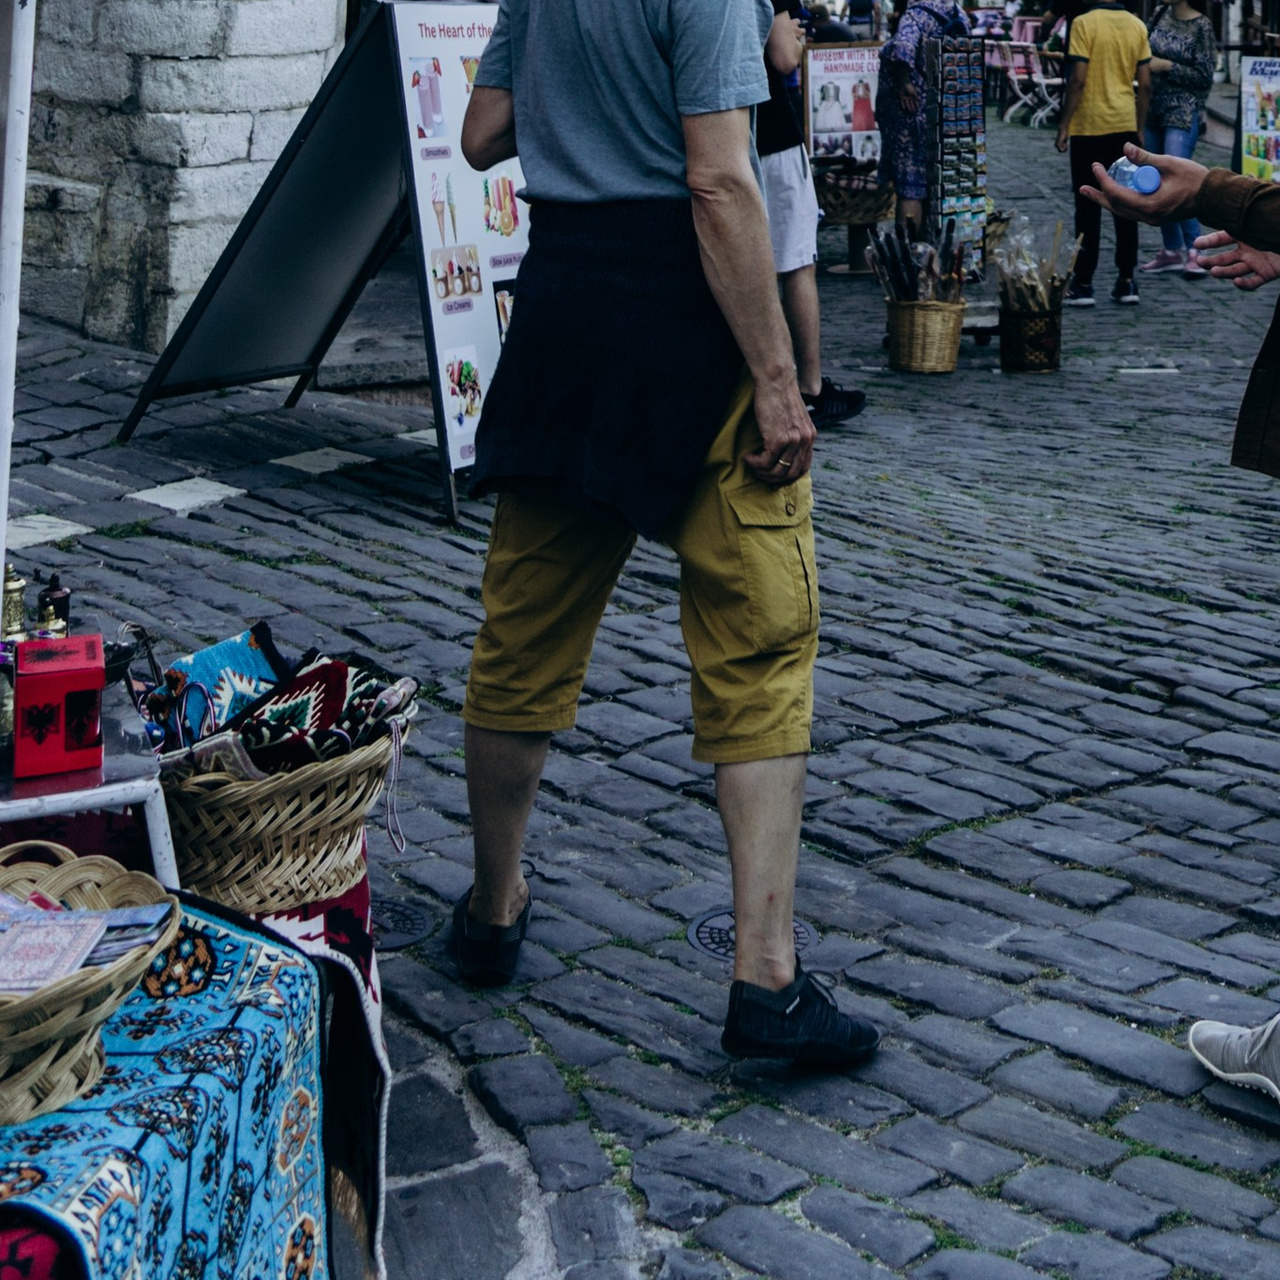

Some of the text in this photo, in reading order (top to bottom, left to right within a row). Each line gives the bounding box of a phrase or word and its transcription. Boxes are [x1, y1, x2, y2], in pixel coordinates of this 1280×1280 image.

[418, 22, 492, 38] The Heart of the
[812, 49, 844, 61] MUSEUM
[846, 49, 865, 60] WITH
[867, 61, 880, 72] CLO
